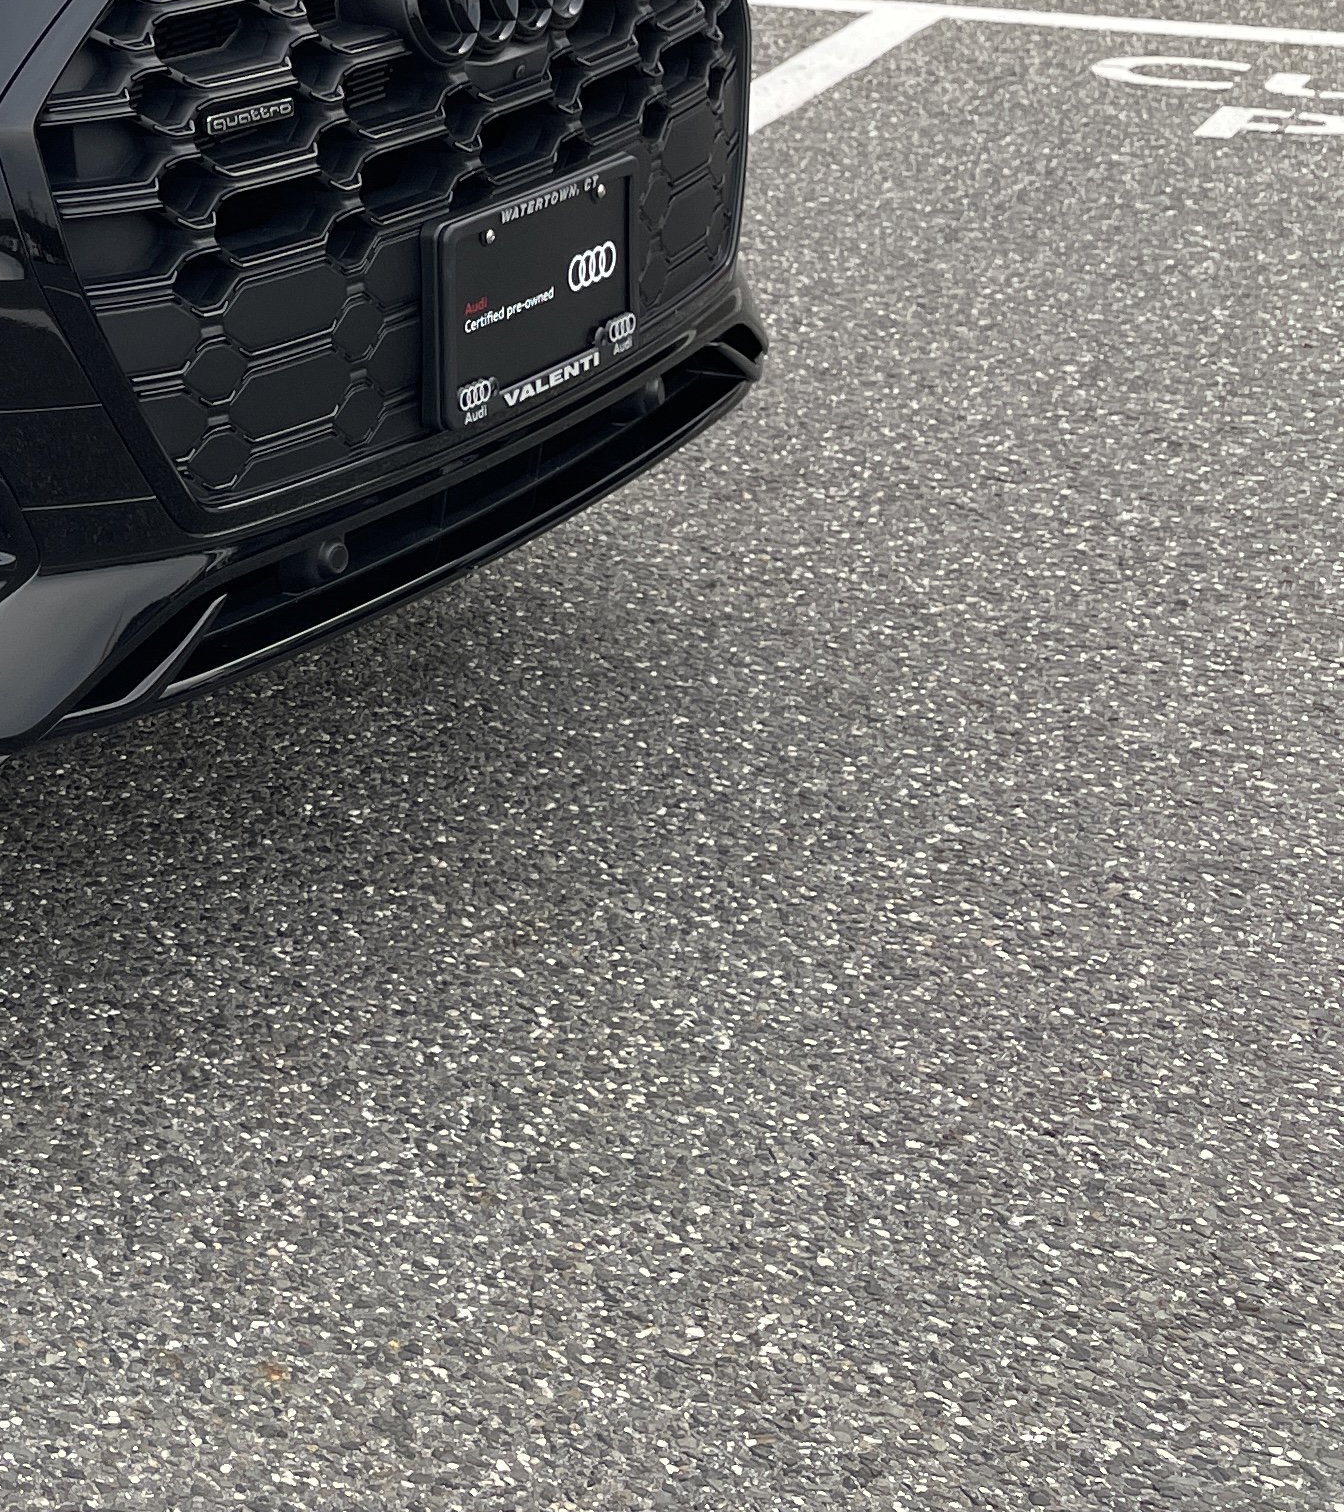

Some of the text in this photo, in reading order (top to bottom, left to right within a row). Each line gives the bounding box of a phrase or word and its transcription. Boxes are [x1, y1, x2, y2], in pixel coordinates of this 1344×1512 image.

[212, 102, 292, 131] quattro
[500, 173, 600, 225] WATERTOWN, CT
[464, 296, 489, 317] Audi
[464, 285, 555, 334] Certified pre-owned
[613, 335, 633, 356] Audi
[503, 351, 601, 407] VALENTI
[464, 404, 489, 426] Audi
